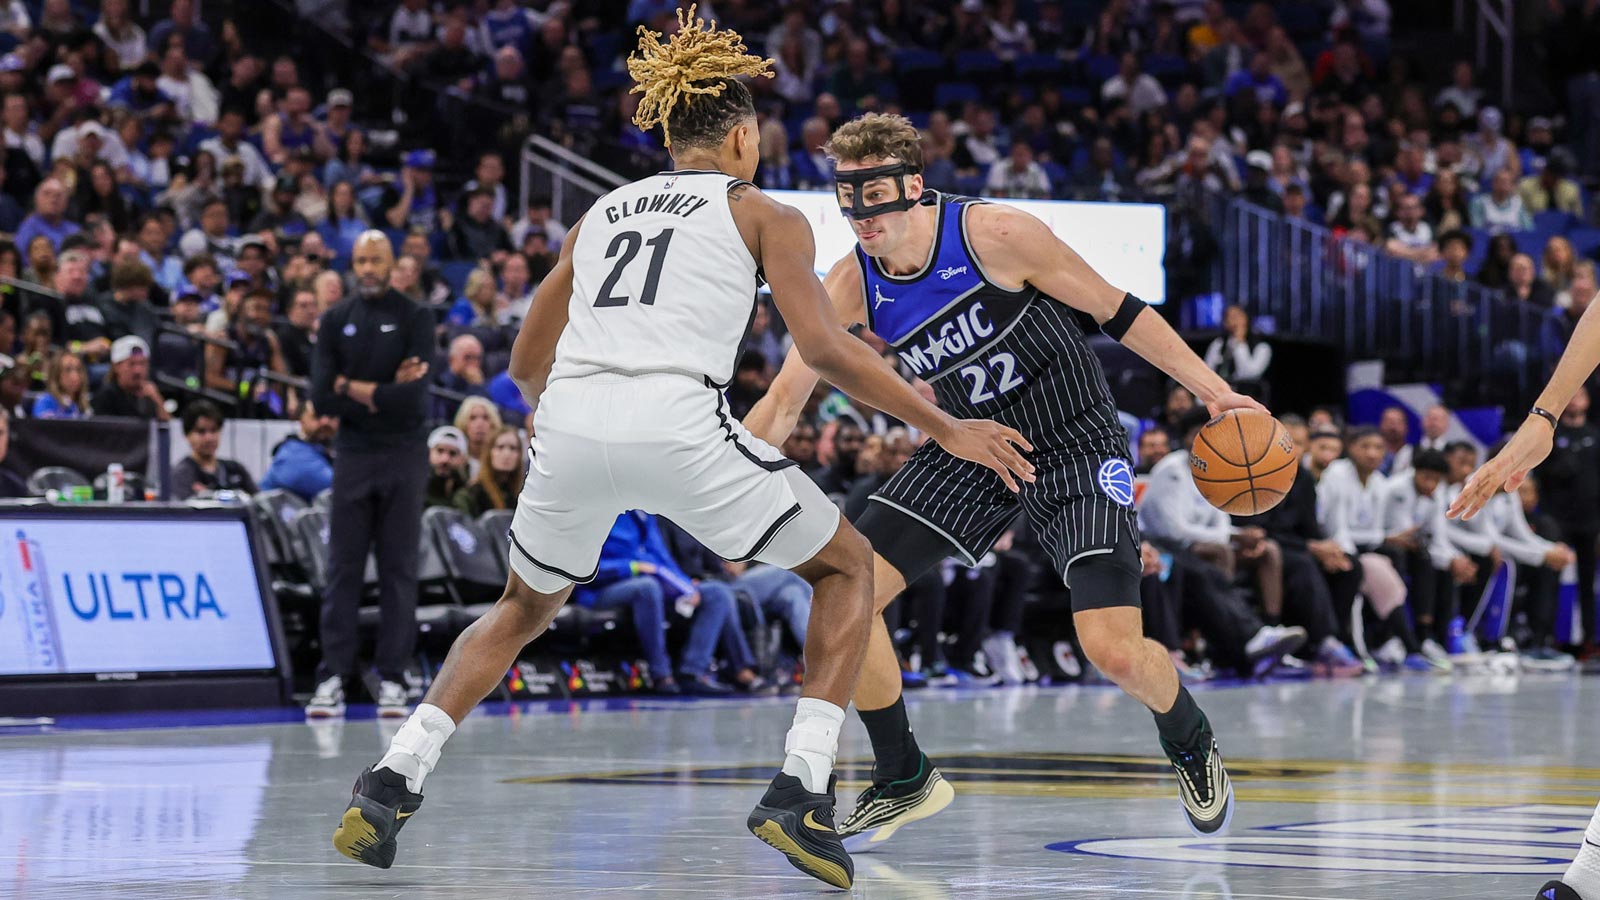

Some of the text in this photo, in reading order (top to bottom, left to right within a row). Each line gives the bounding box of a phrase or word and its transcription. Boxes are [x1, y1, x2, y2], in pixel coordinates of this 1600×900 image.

[605, 193, 709, 224] CLOWNEY
[593, 228, 674, 308] 21
[937, 265, 968, 280] Disney
[960, 352, 1024, 405] 22
[63, 573, 226, 620] ULTRA
